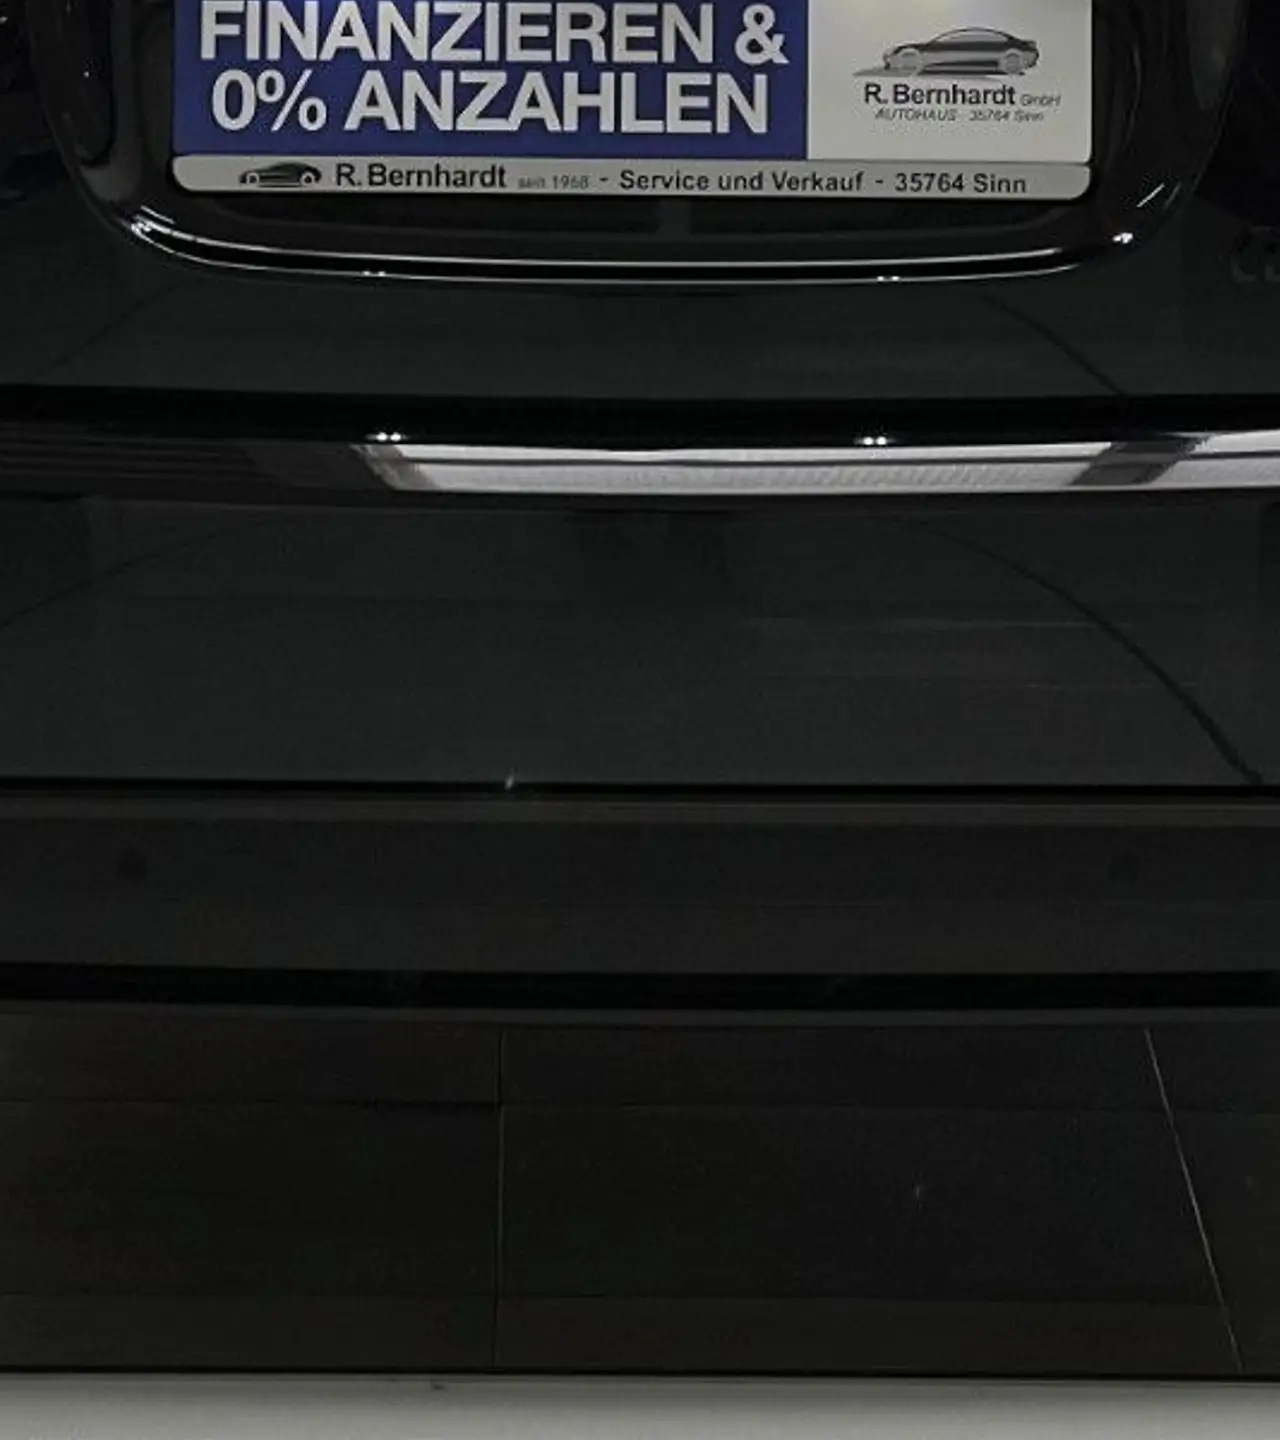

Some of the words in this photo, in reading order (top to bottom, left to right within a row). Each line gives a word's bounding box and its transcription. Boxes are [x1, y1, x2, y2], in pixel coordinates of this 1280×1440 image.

[200, 0, 714, 63] FINANZIEREN
[734, 3, 790, 65] &
[211, 68, 328, 132] 0%
[343, 69, 768, 134] ANZAHLEN
[864, 83, 889, 105] R.
[893, 83, 1016, 105] Bernhardt
[874, 109, 957, 122] AUTOHAUS
[335, 163, 362, 187] R.
[368, 163, 507, 188] Bernhardt
[552, 174, 590, 190] 1968
[619, 169, 710, 191] Service
[717, 171, 763, 191] und
[771, 170, 864, 192] Verkauf
[893, 172, 966, 193] 35764
[972, 173, 1027, 194] Sinn
